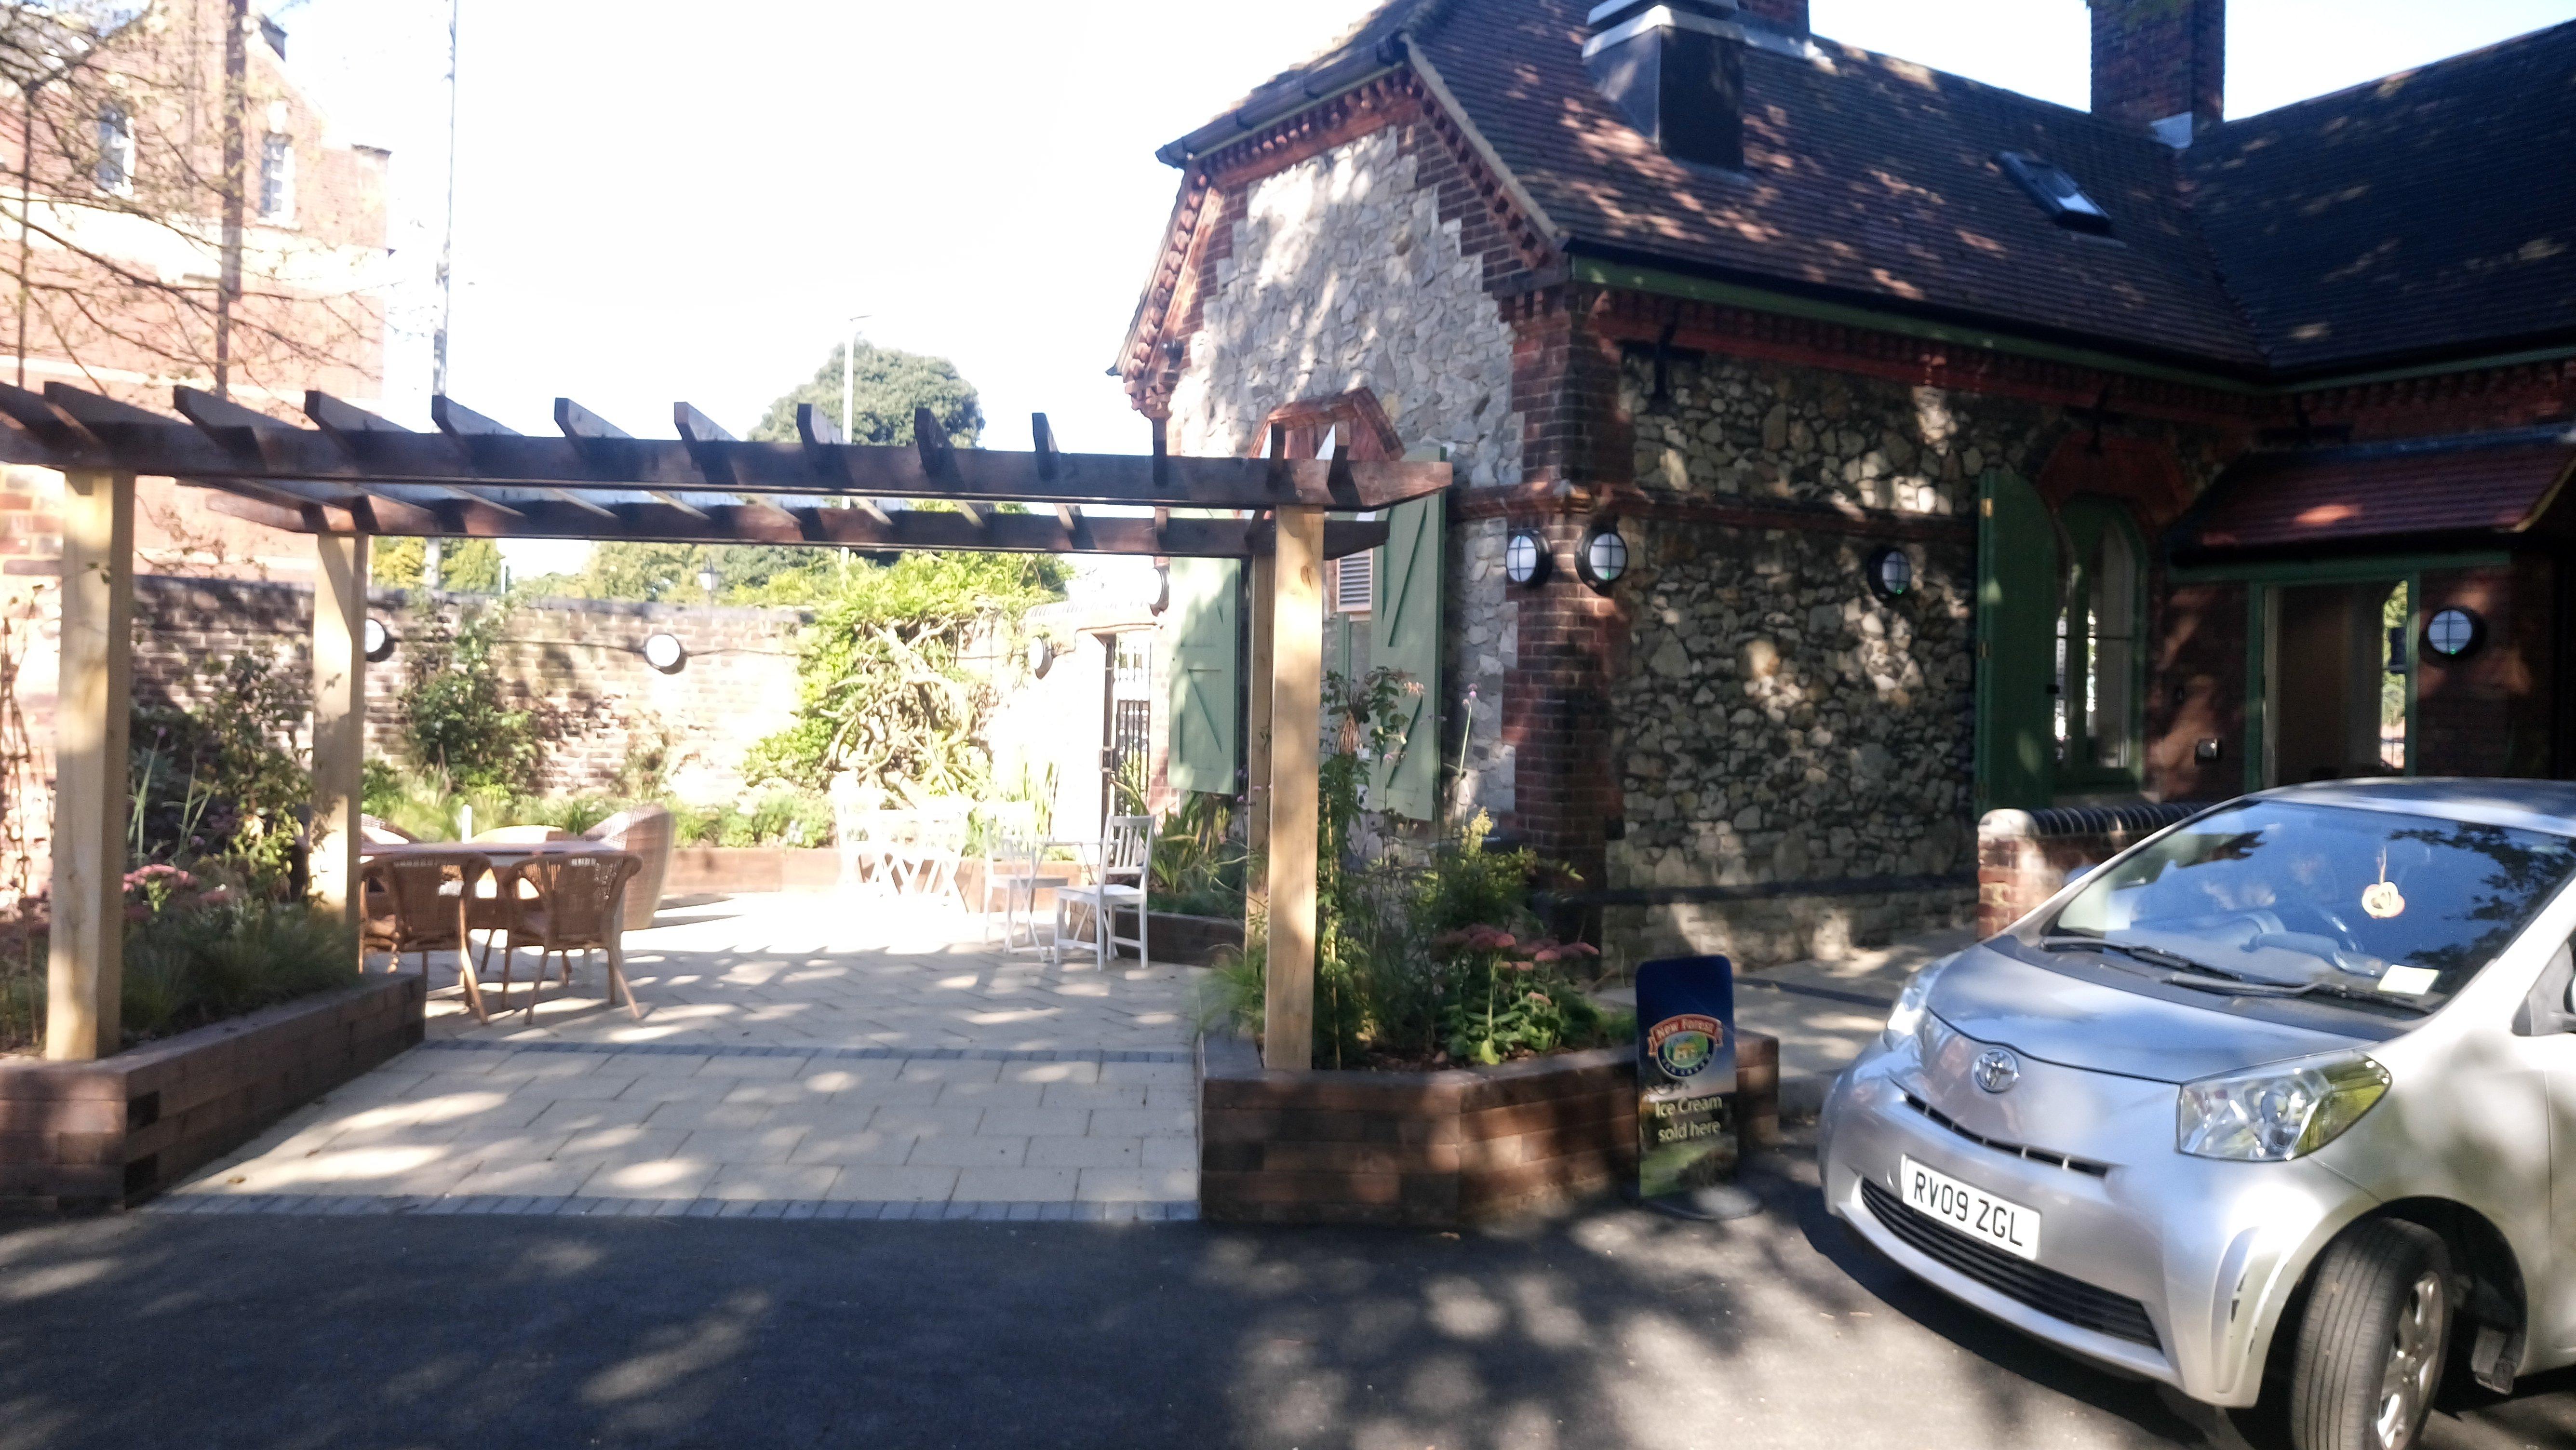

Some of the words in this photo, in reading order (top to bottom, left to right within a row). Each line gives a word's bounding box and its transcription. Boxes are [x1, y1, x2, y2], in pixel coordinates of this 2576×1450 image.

[1655, 1101, 1675, 1118] Ice
[1678, 1097, 1722, 1113] Cream
[1658, 1122, 1687, 1142] sold
[1690, 1121, 1721, 1137] here
[1914, 1171, 1968, 1222] RV09
[1976, 1198, 2022, 1247] ZGL
